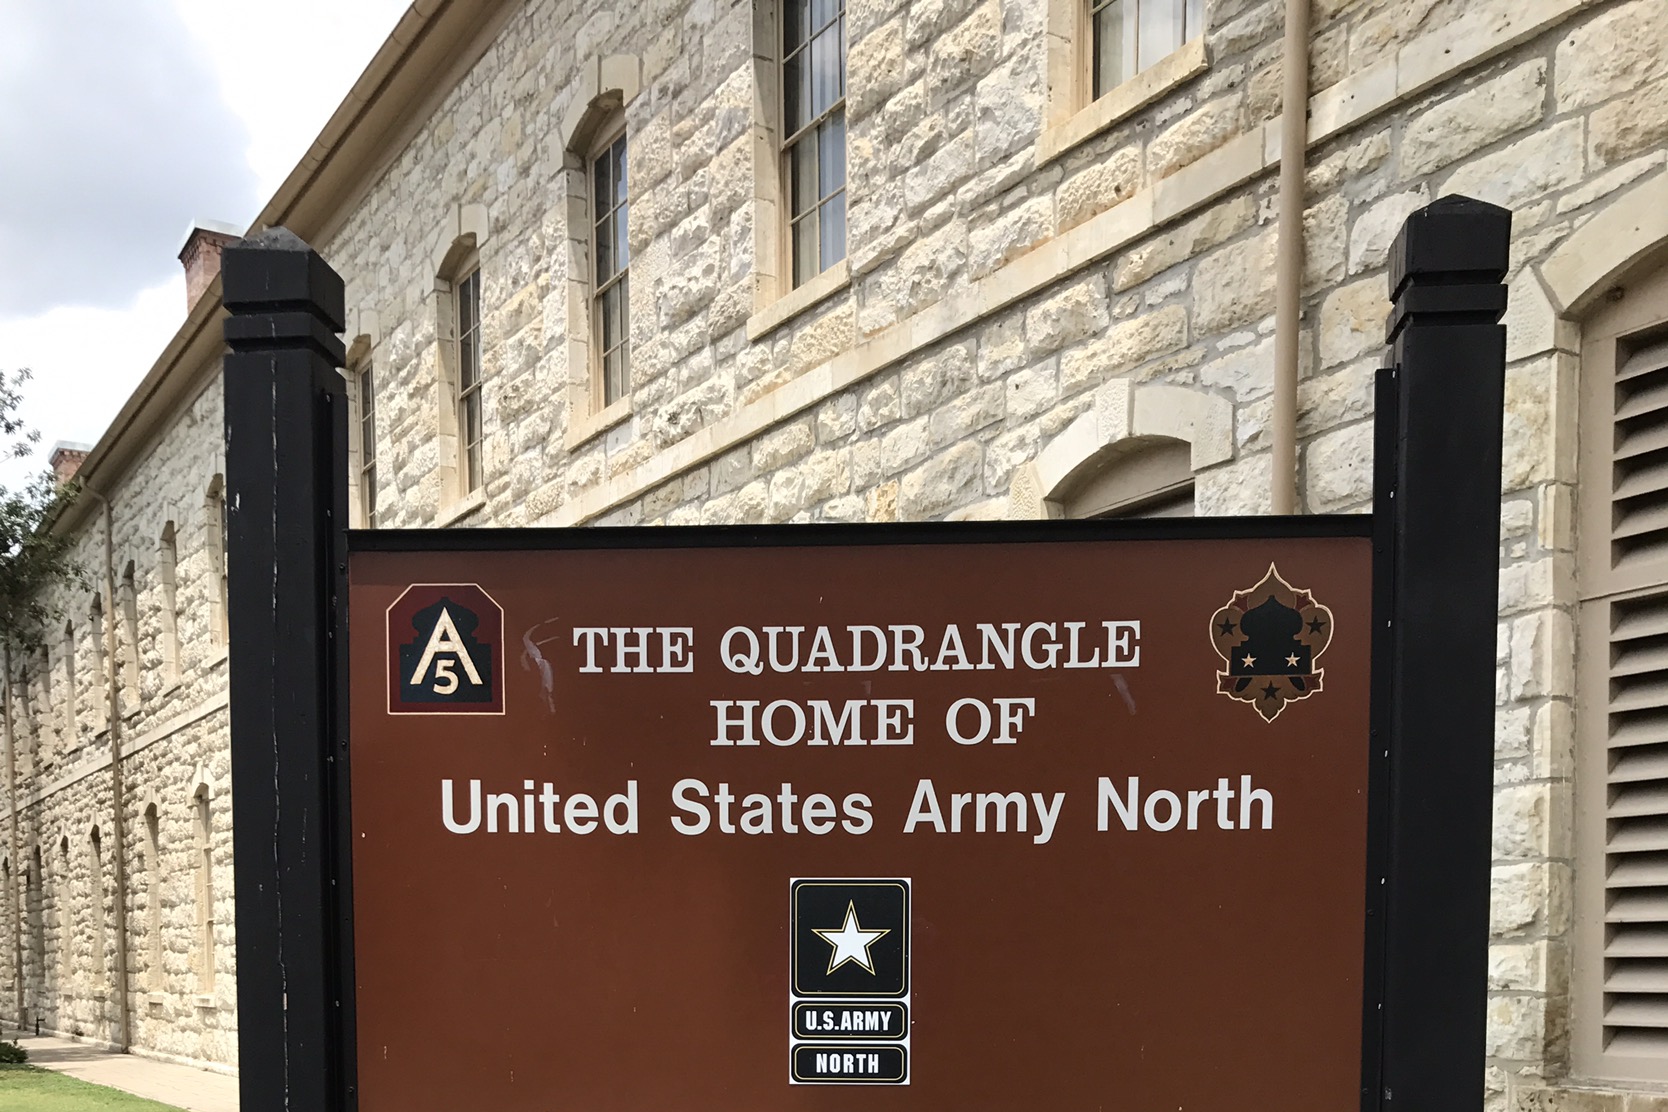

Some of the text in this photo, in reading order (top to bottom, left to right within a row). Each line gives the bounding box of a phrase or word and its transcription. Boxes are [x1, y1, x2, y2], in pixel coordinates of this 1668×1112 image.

[410, 606, 483, 685] A
[572, 620, 1141, 676] THE QUADRANGLE
[433, 659, 459, 695] 5
[709, 697, 1036, 746] HOME OF
[441, 775, 1273, 845] United States Army North
[816, 1053, 879, 1074] NORTH
